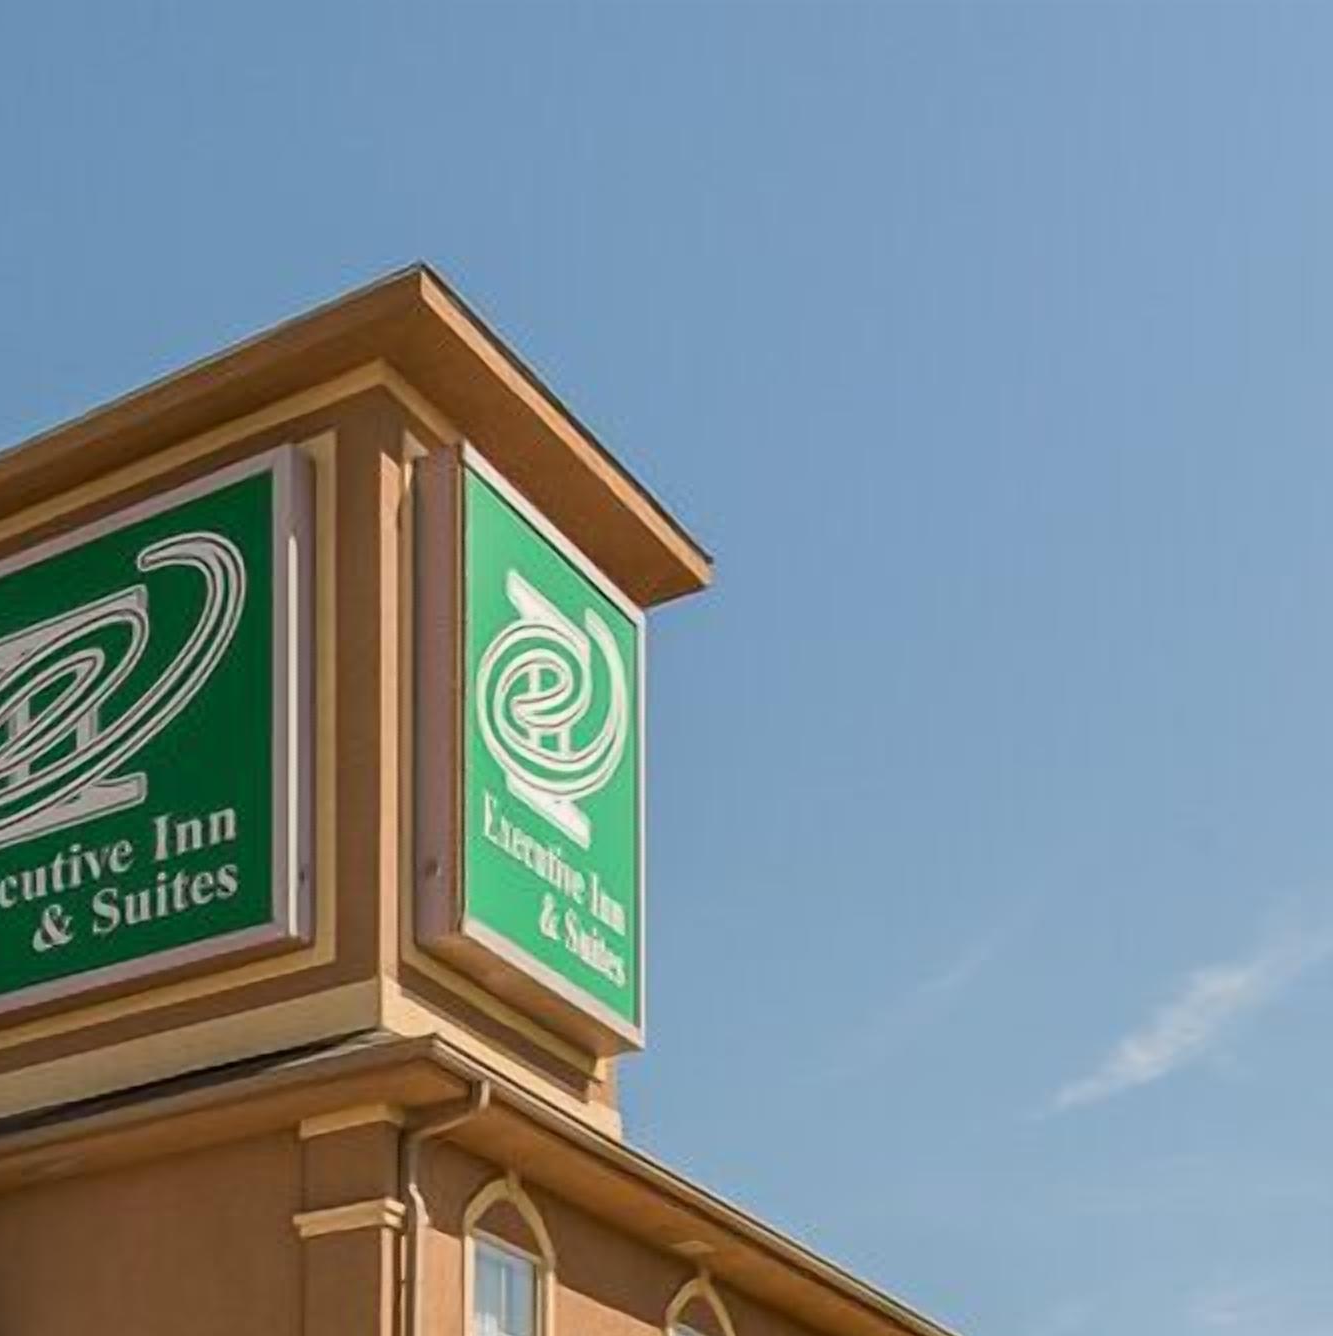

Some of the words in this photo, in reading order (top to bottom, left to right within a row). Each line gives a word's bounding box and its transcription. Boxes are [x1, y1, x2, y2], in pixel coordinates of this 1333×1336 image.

[154, 807, 237, 861] Inn
[484, 791, 586, 905] Executive
[590, 872, 626, 937] Inn
[33, 904, 74, 951] &
[92, 863, 239, 935] Suites
[539, 892, 561, 941] &
[564, 908, 626, 988] Suites
